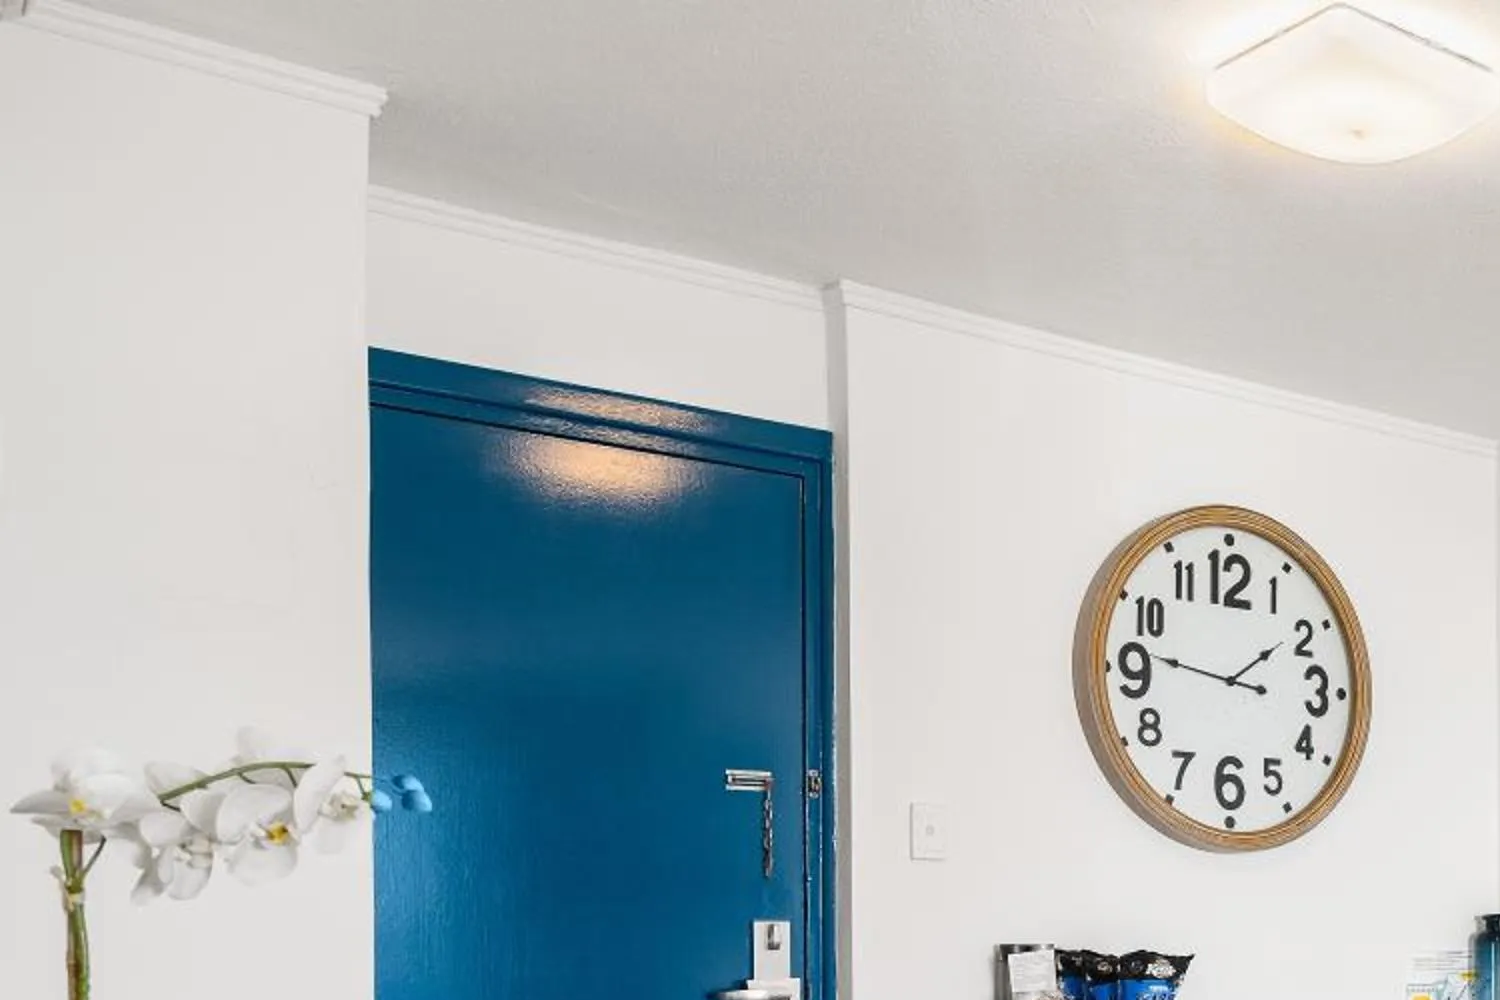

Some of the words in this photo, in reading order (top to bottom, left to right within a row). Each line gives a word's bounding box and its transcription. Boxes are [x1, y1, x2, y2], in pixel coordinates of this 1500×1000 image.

[1173, 559, 1195, 602] 11
[1207, 548, 1252, 611] 12
[1268, 576, 1278, 615] 1
[1134, 595, 1165, 638] 10
[1294, 619, 1314, 658] 2
[1117, 641, 1152, 700] 9
[1304, 664, 1329, 718] 3
[1137, 707, 1163, 747] 8
[1294, 723, 1315, 761] 4
[1171, 750, 1196, 791] 7
[1214, 755, 1246, 811] 6
[1263, 757, 1283, 797] 5
